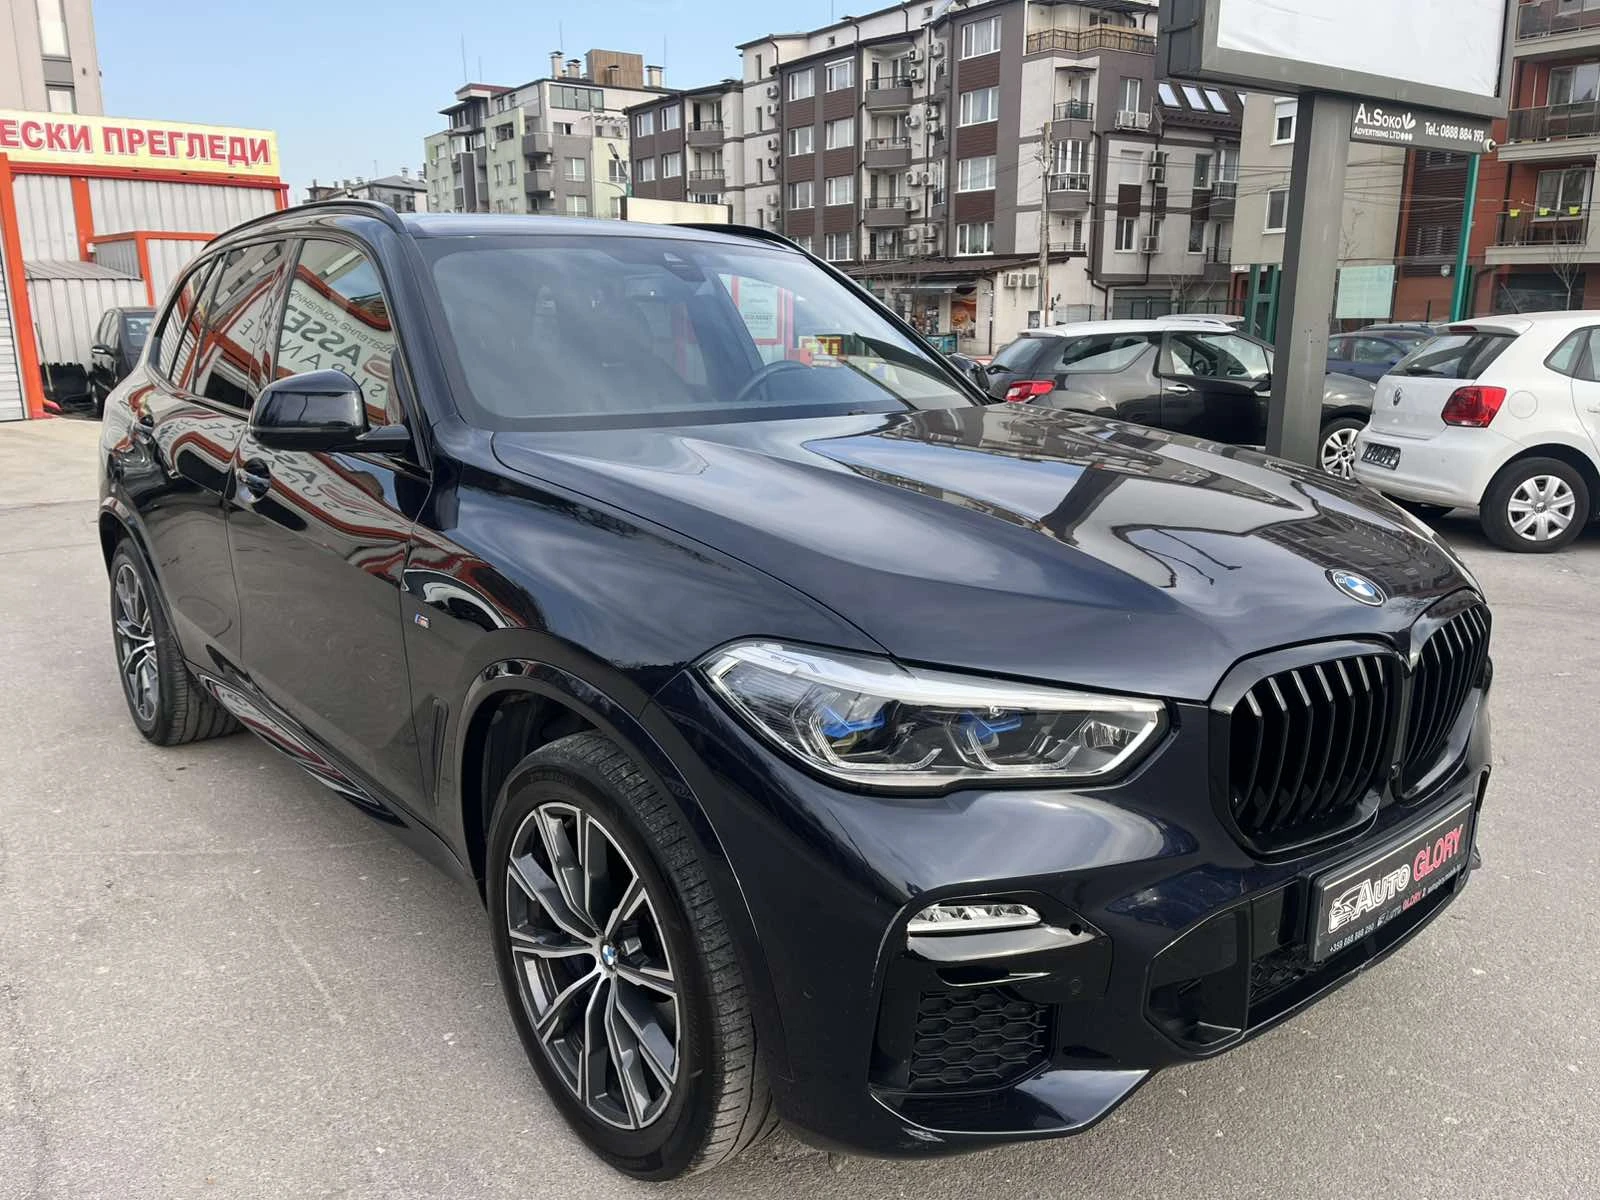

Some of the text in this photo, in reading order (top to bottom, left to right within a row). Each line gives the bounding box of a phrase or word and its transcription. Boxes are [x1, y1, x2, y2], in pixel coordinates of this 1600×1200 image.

[0, 119, 271, 167] ЕСКИ ПРЕГЛЕДИ
[1440, 124, 1458, 139] 0888
[1459, 127, 1473, 141] 884
[1473, 130, 1485, 143] 193
[1353, 864, 1410, 917] AUTO
[1413, 824, 1463, 881] GLORY
